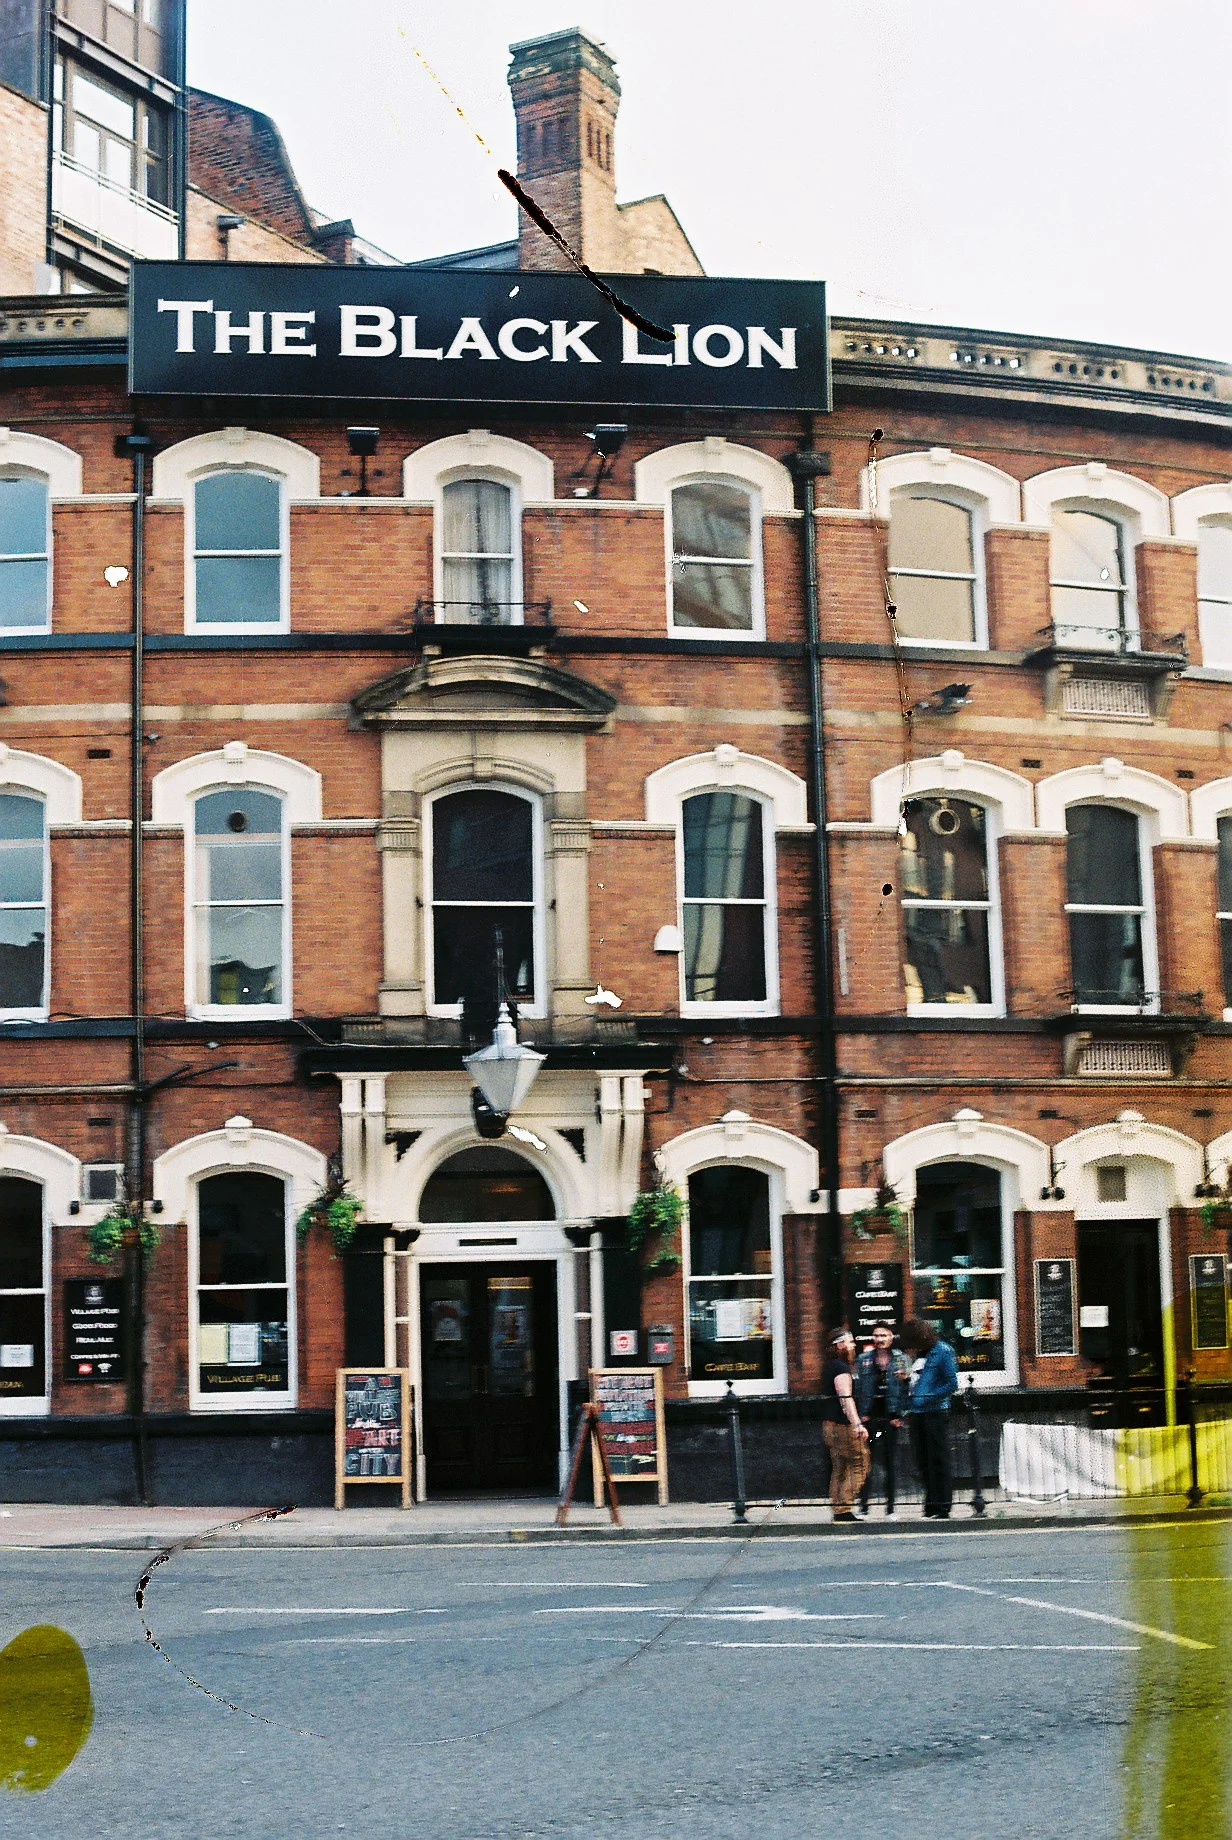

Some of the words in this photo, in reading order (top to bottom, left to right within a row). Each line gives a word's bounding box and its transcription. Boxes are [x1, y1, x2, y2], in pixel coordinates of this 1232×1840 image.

[157, 298, 317, 357] THE
[338, 304, 602, 364] BLACK
[620, 315, 799, 370] LION
[207, 1375, 255, 1383] VILLAGE
[255, 1373, 281, 1382] PUB
